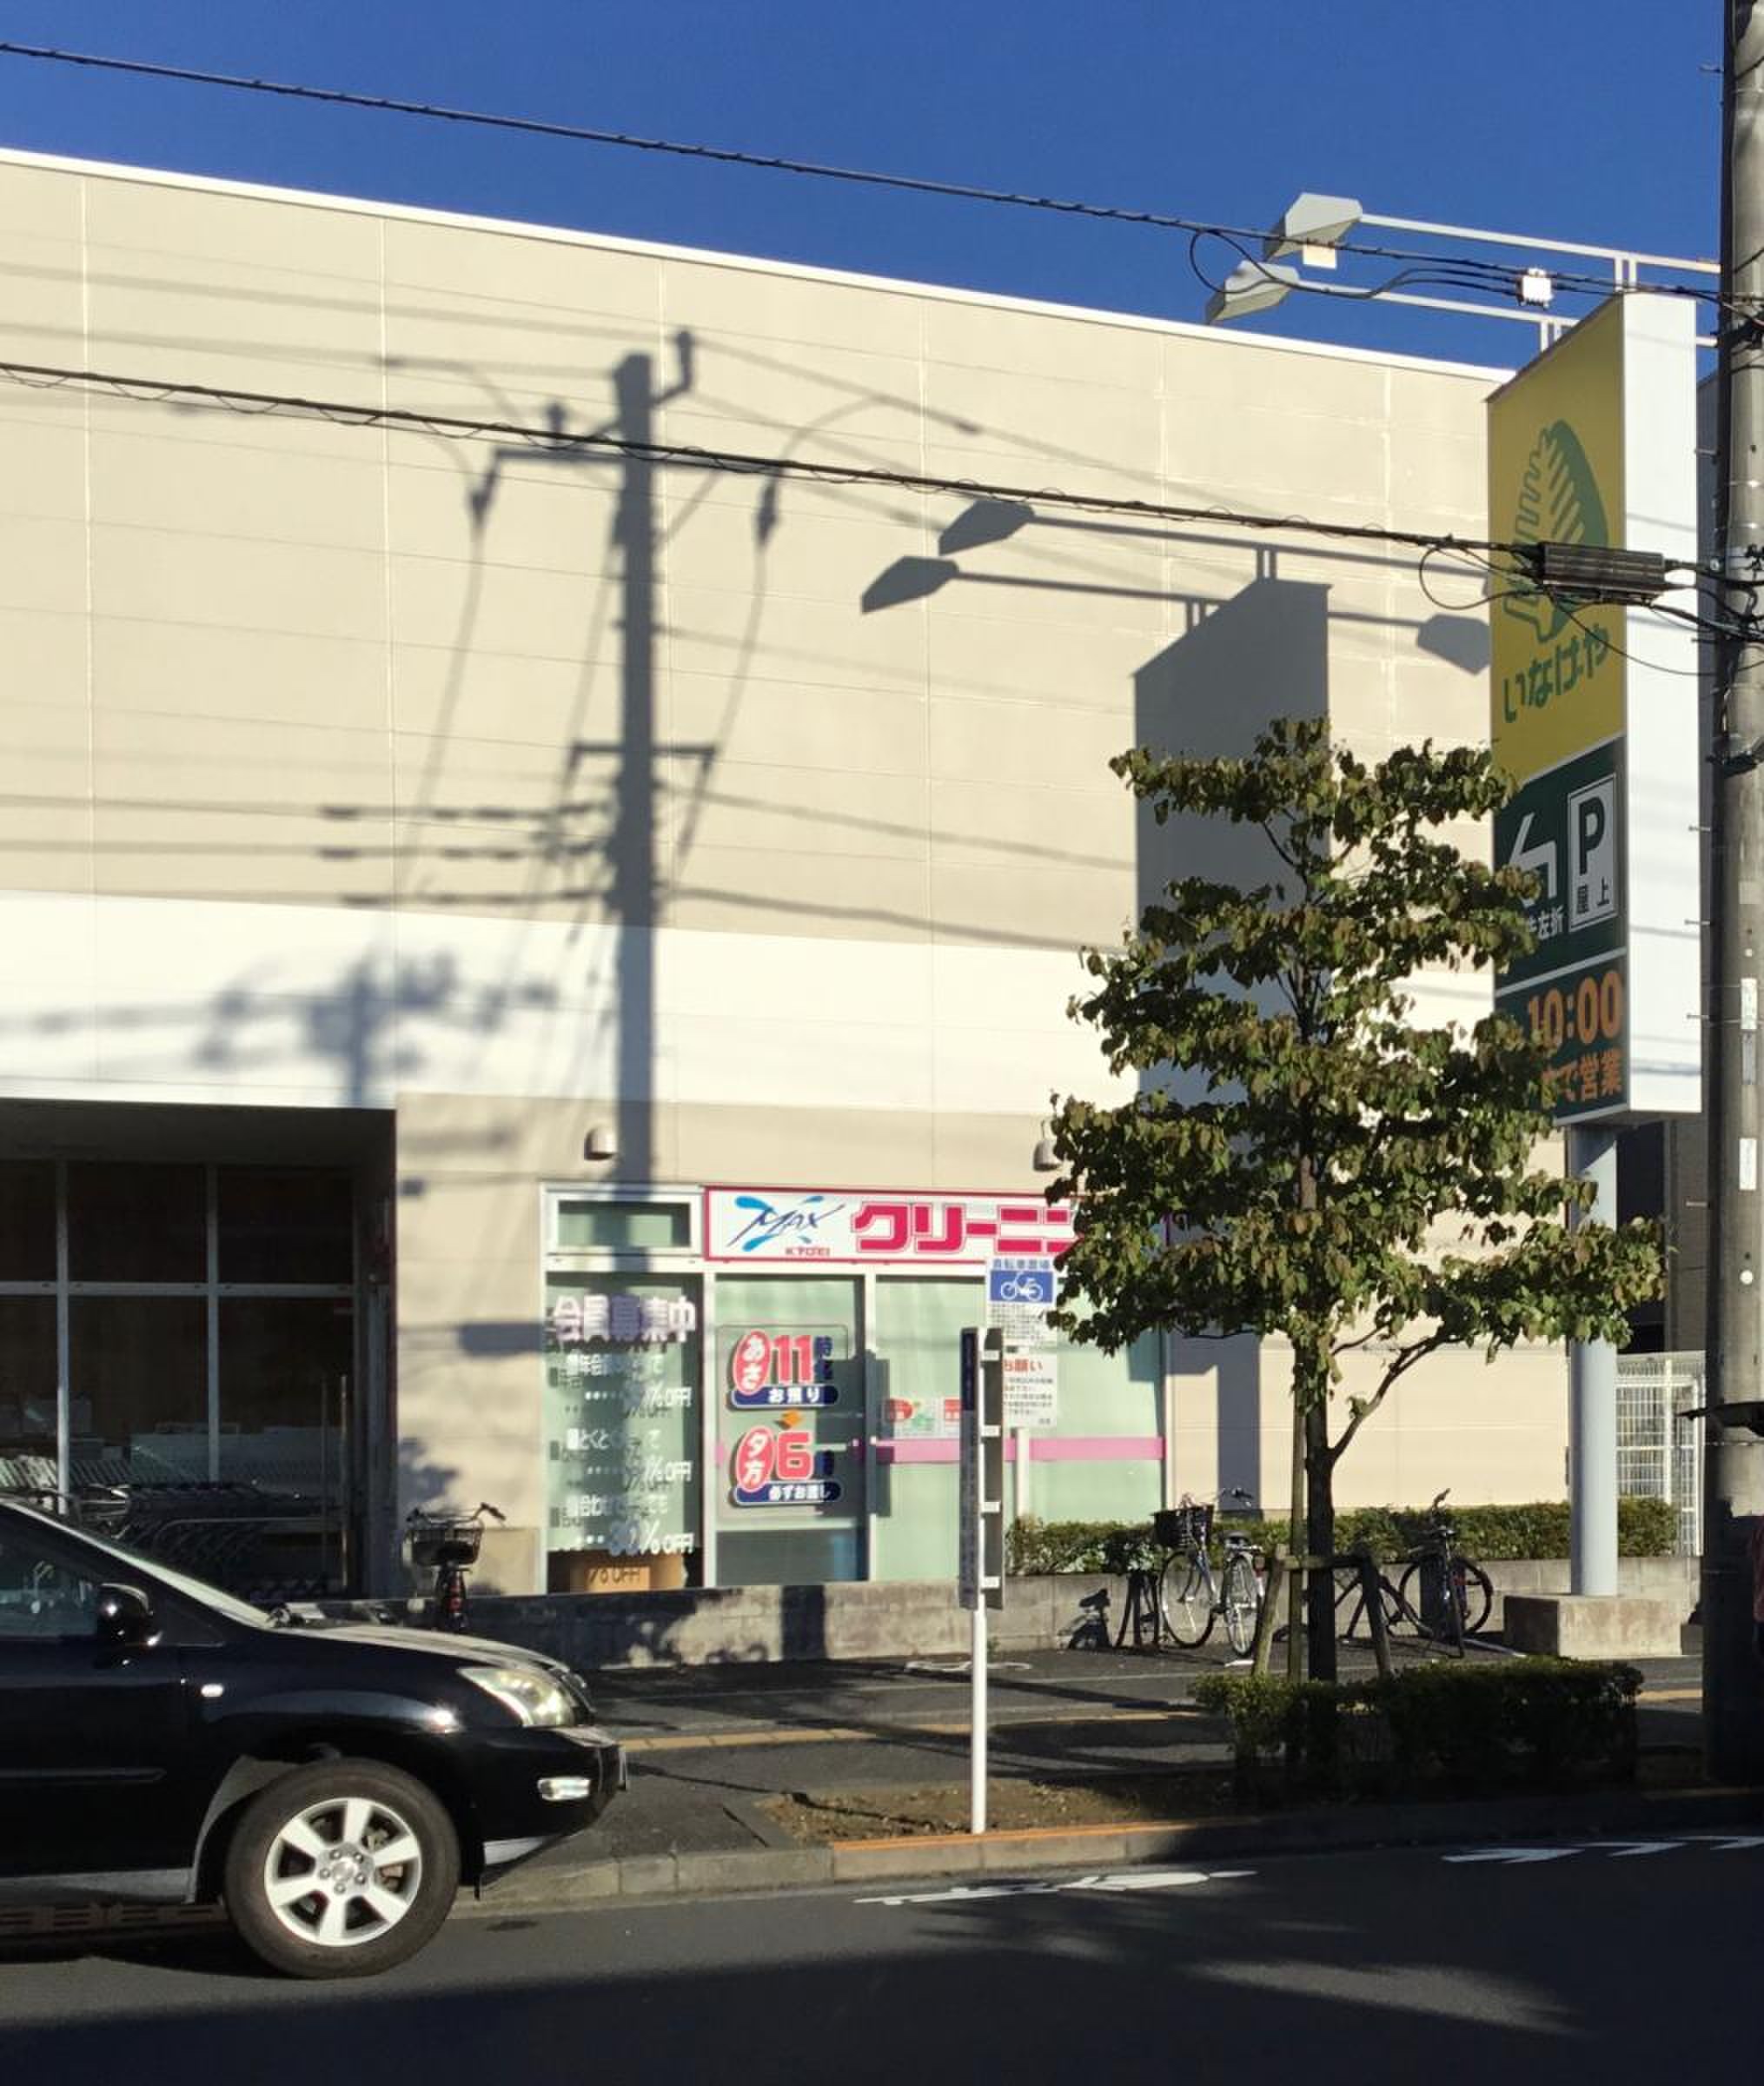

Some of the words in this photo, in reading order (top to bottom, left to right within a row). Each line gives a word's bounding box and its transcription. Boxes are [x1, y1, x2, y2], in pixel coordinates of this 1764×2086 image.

[1578, 795, 1606, 875] P
[1529, 969, 1623, 1052] 10:00
[773, 1334, 814, 1385] 11
[776, 1431, 814, 1480] 6
